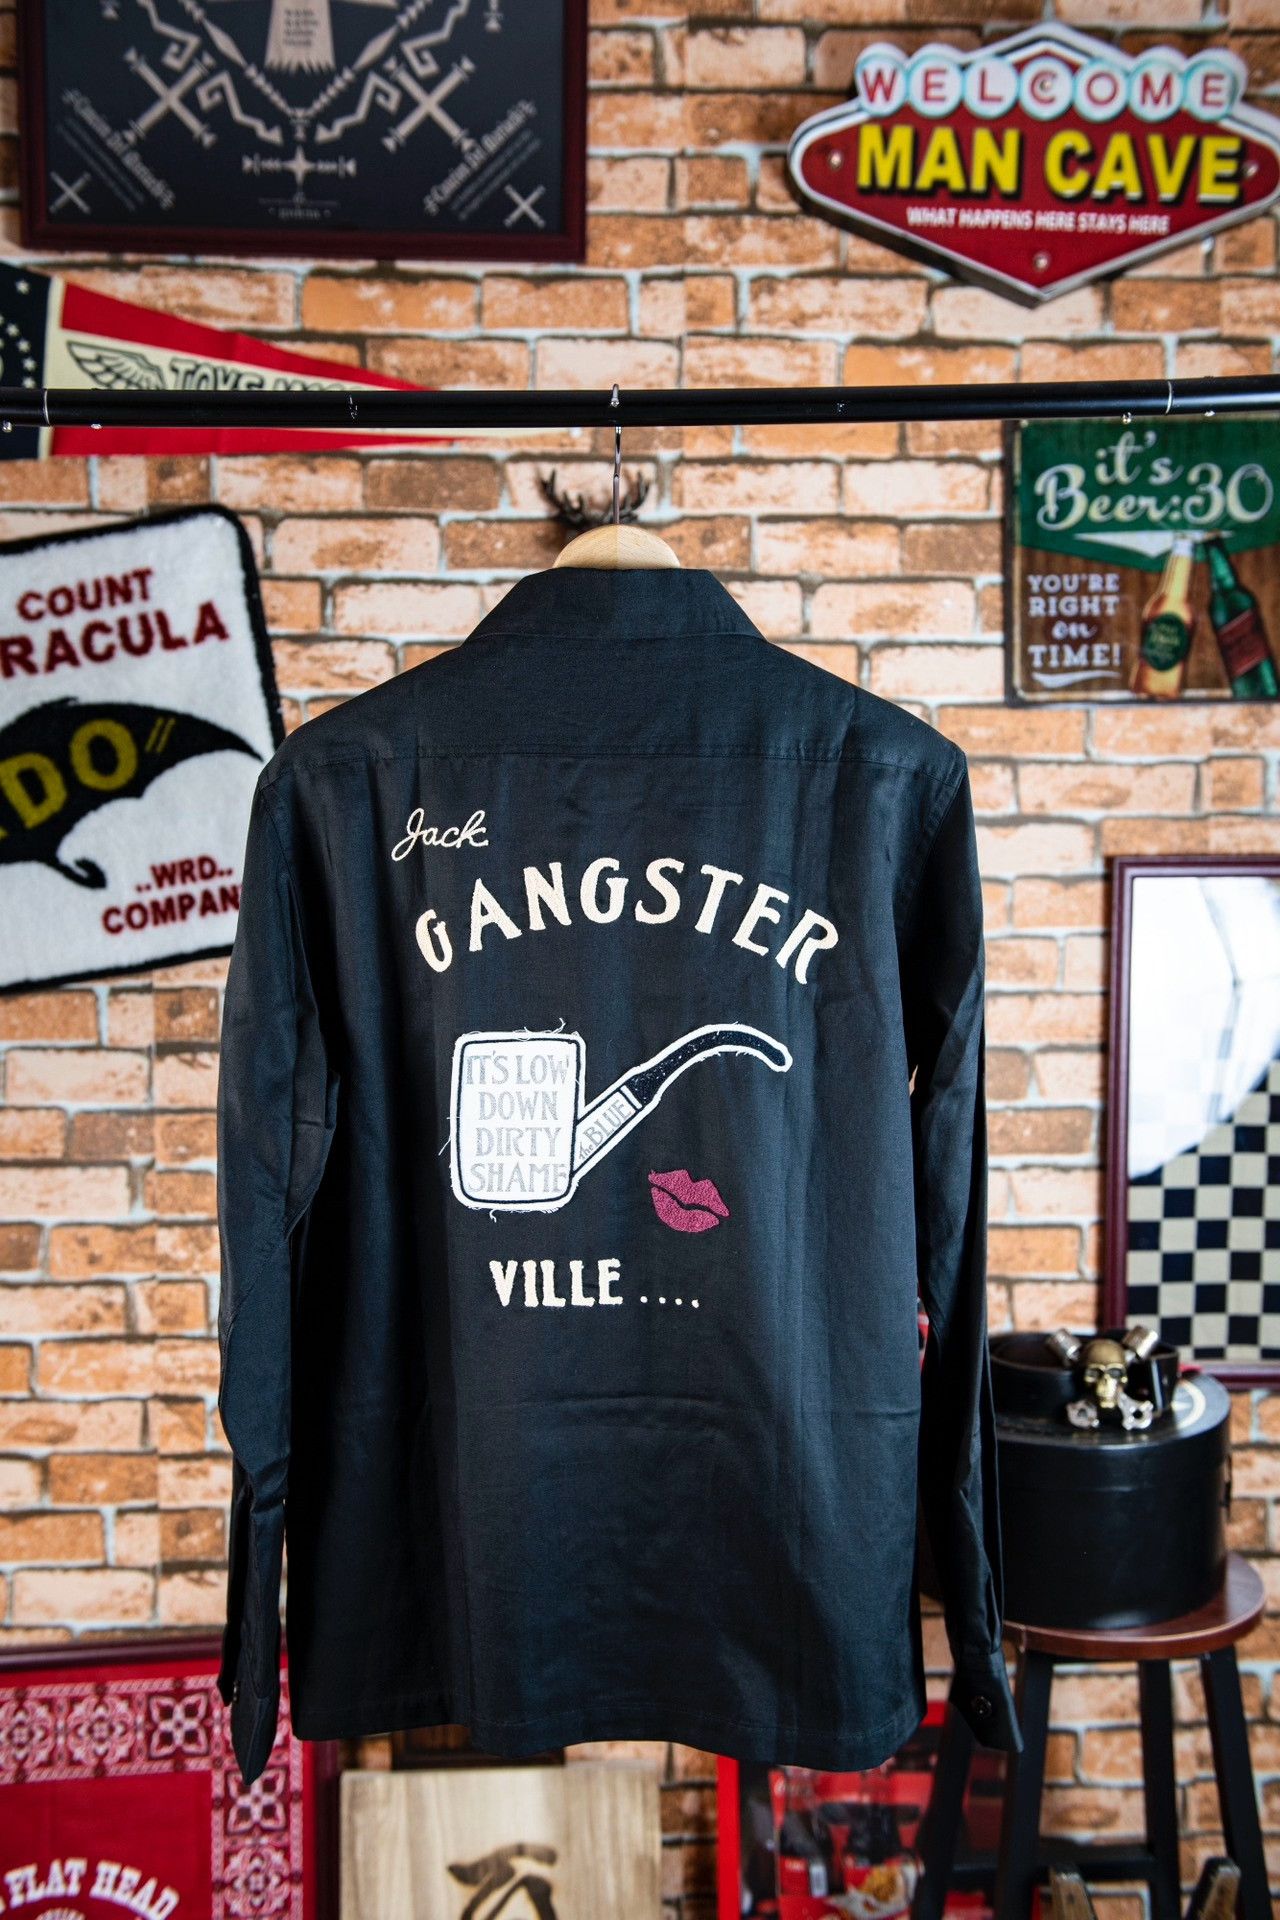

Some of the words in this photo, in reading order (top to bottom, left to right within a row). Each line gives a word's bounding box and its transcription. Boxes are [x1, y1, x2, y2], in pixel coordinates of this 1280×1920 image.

[863, 67, 1226, 107] WELCOME
[856, 124, 1021, 194] MAN
[1045, 130, 1242, 202] CAVE
[906, 207, 957, 227] WHAT
[959, 208, 1033, 230] HAPPENS
[1034, 211, 1075, 232] HERE
[1077, 212, 1126, 233] STAYS
[1128, 214, 1171, 235] HERE
[1095, 431, 1184, 485] it's
[16, 567, 154, 622] COUNT
[1027, 573, 1120, 594] YOU'RE
[1028, 595, 1120, 618] RIGHT
[1052, 619, 1098, 640] on
[1027, 644, 1121, 669] TIME!
[391, 807, 489, 862] Jack
[102, 884, 243, 935] COMPAN
[415, 856, 839, 985] GANGSTER
[466, 1050, 509, 1085] IT'S
[516, 1055, 569, 1085] LOW
[478, 1091, 559, 1121] DOWN
[583, 1099, 632, 1147] BLUE
[475, 1127, 562, 1157] DIRTY
[468, 1162, 567, 1193] SHAME
[489, 1258, 624, 1308] VILLE
[4, 1857, 88, 1907] FLAT
[89, 1859, 180, 1920] HEAD
